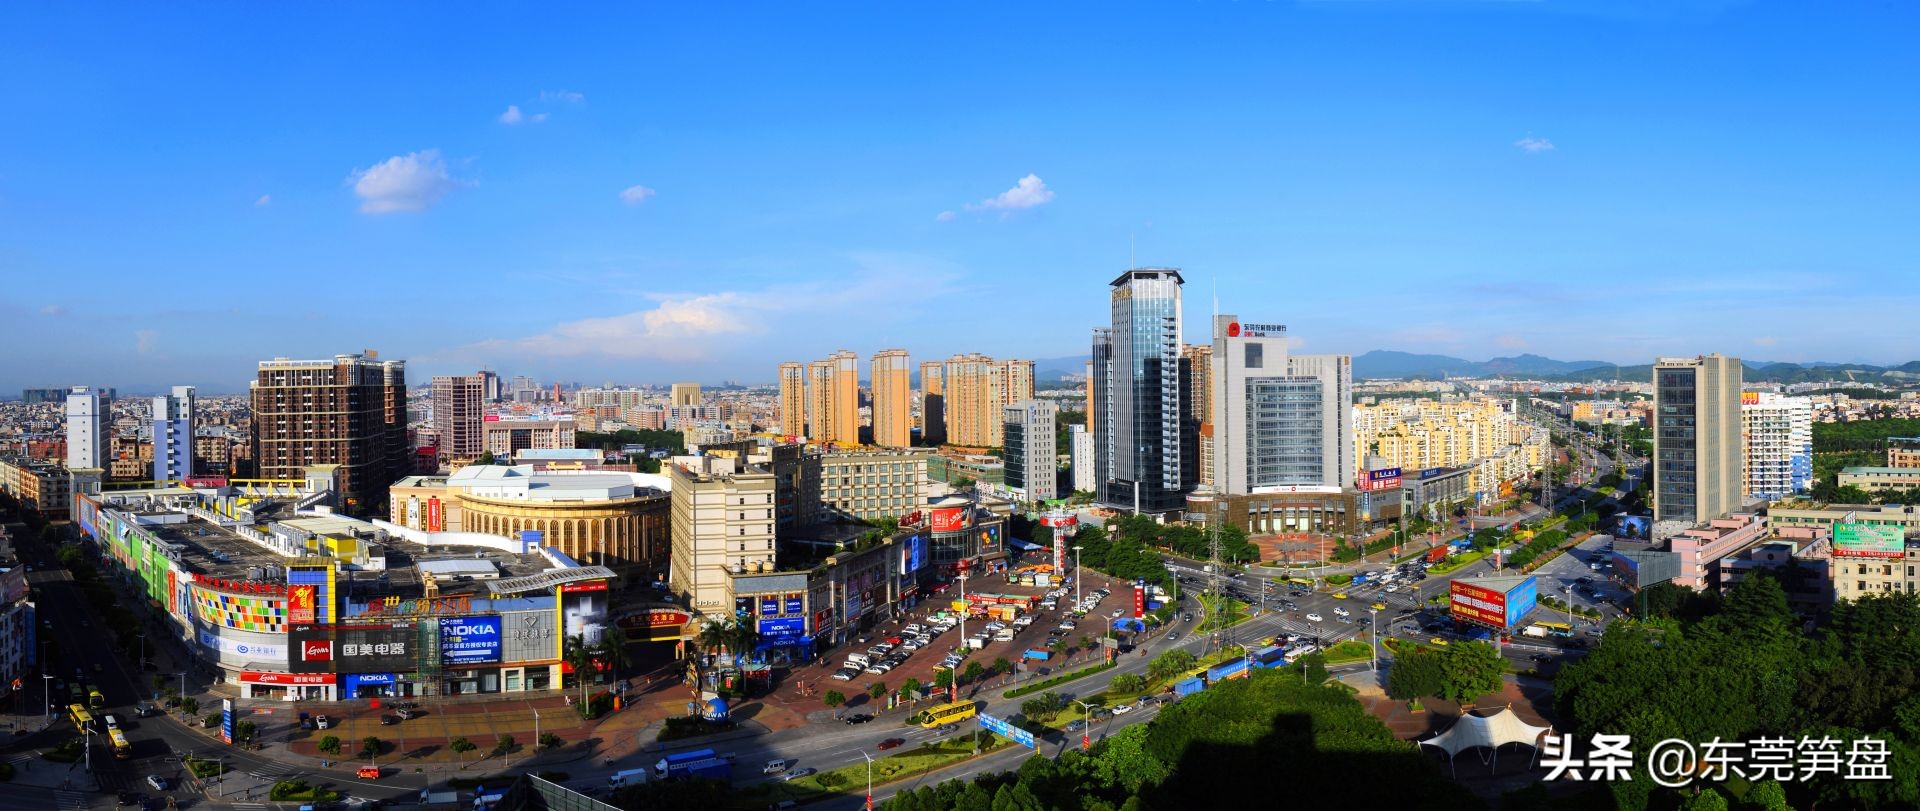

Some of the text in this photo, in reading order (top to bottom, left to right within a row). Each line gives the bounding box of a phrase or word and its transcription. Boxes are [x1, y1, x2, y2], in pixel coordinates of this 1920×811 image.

[441, 624, 497, 636] NOKIA
[342, 642, 405, 657] 国美电器
